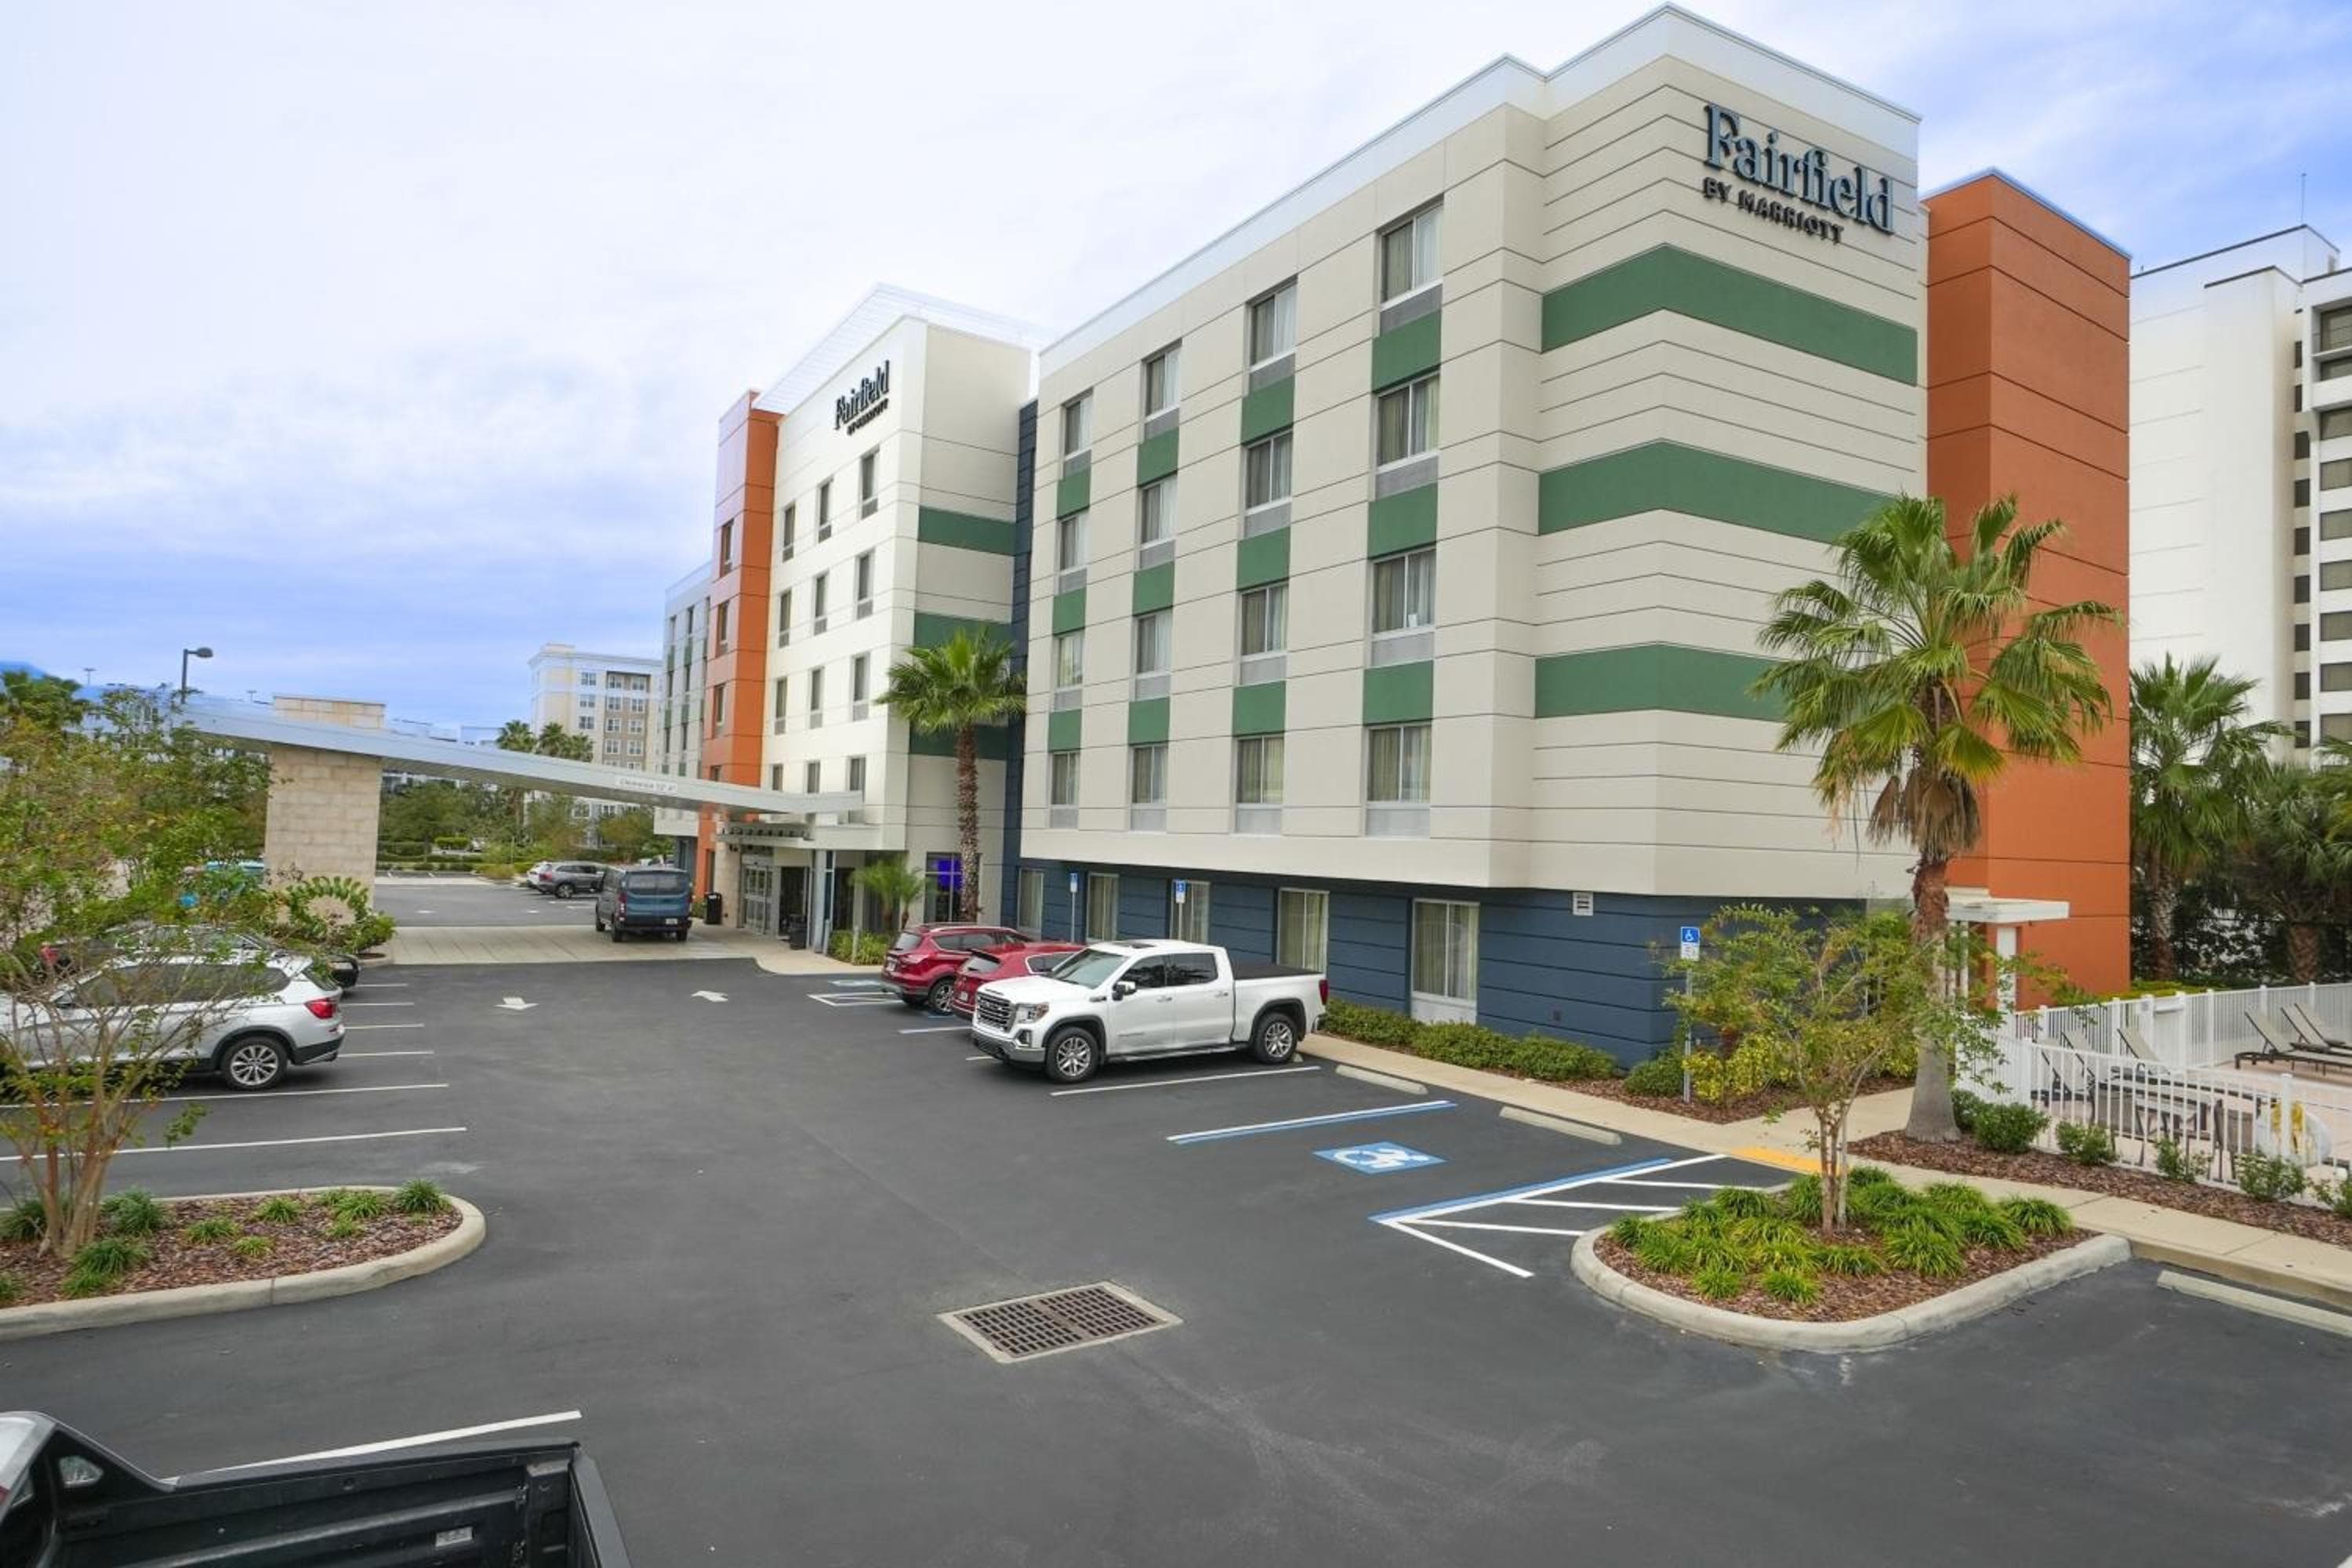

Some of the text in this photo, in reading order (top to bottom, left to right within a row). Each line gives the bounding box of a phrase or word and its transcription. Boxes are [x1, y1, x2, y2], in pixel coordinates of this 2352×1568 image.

[1704, 103, 1895, 234] Fairfield
[1703, 176, 1844, 244] BY MARRIOTT
[833, 360, 890, 430] Fairfield
